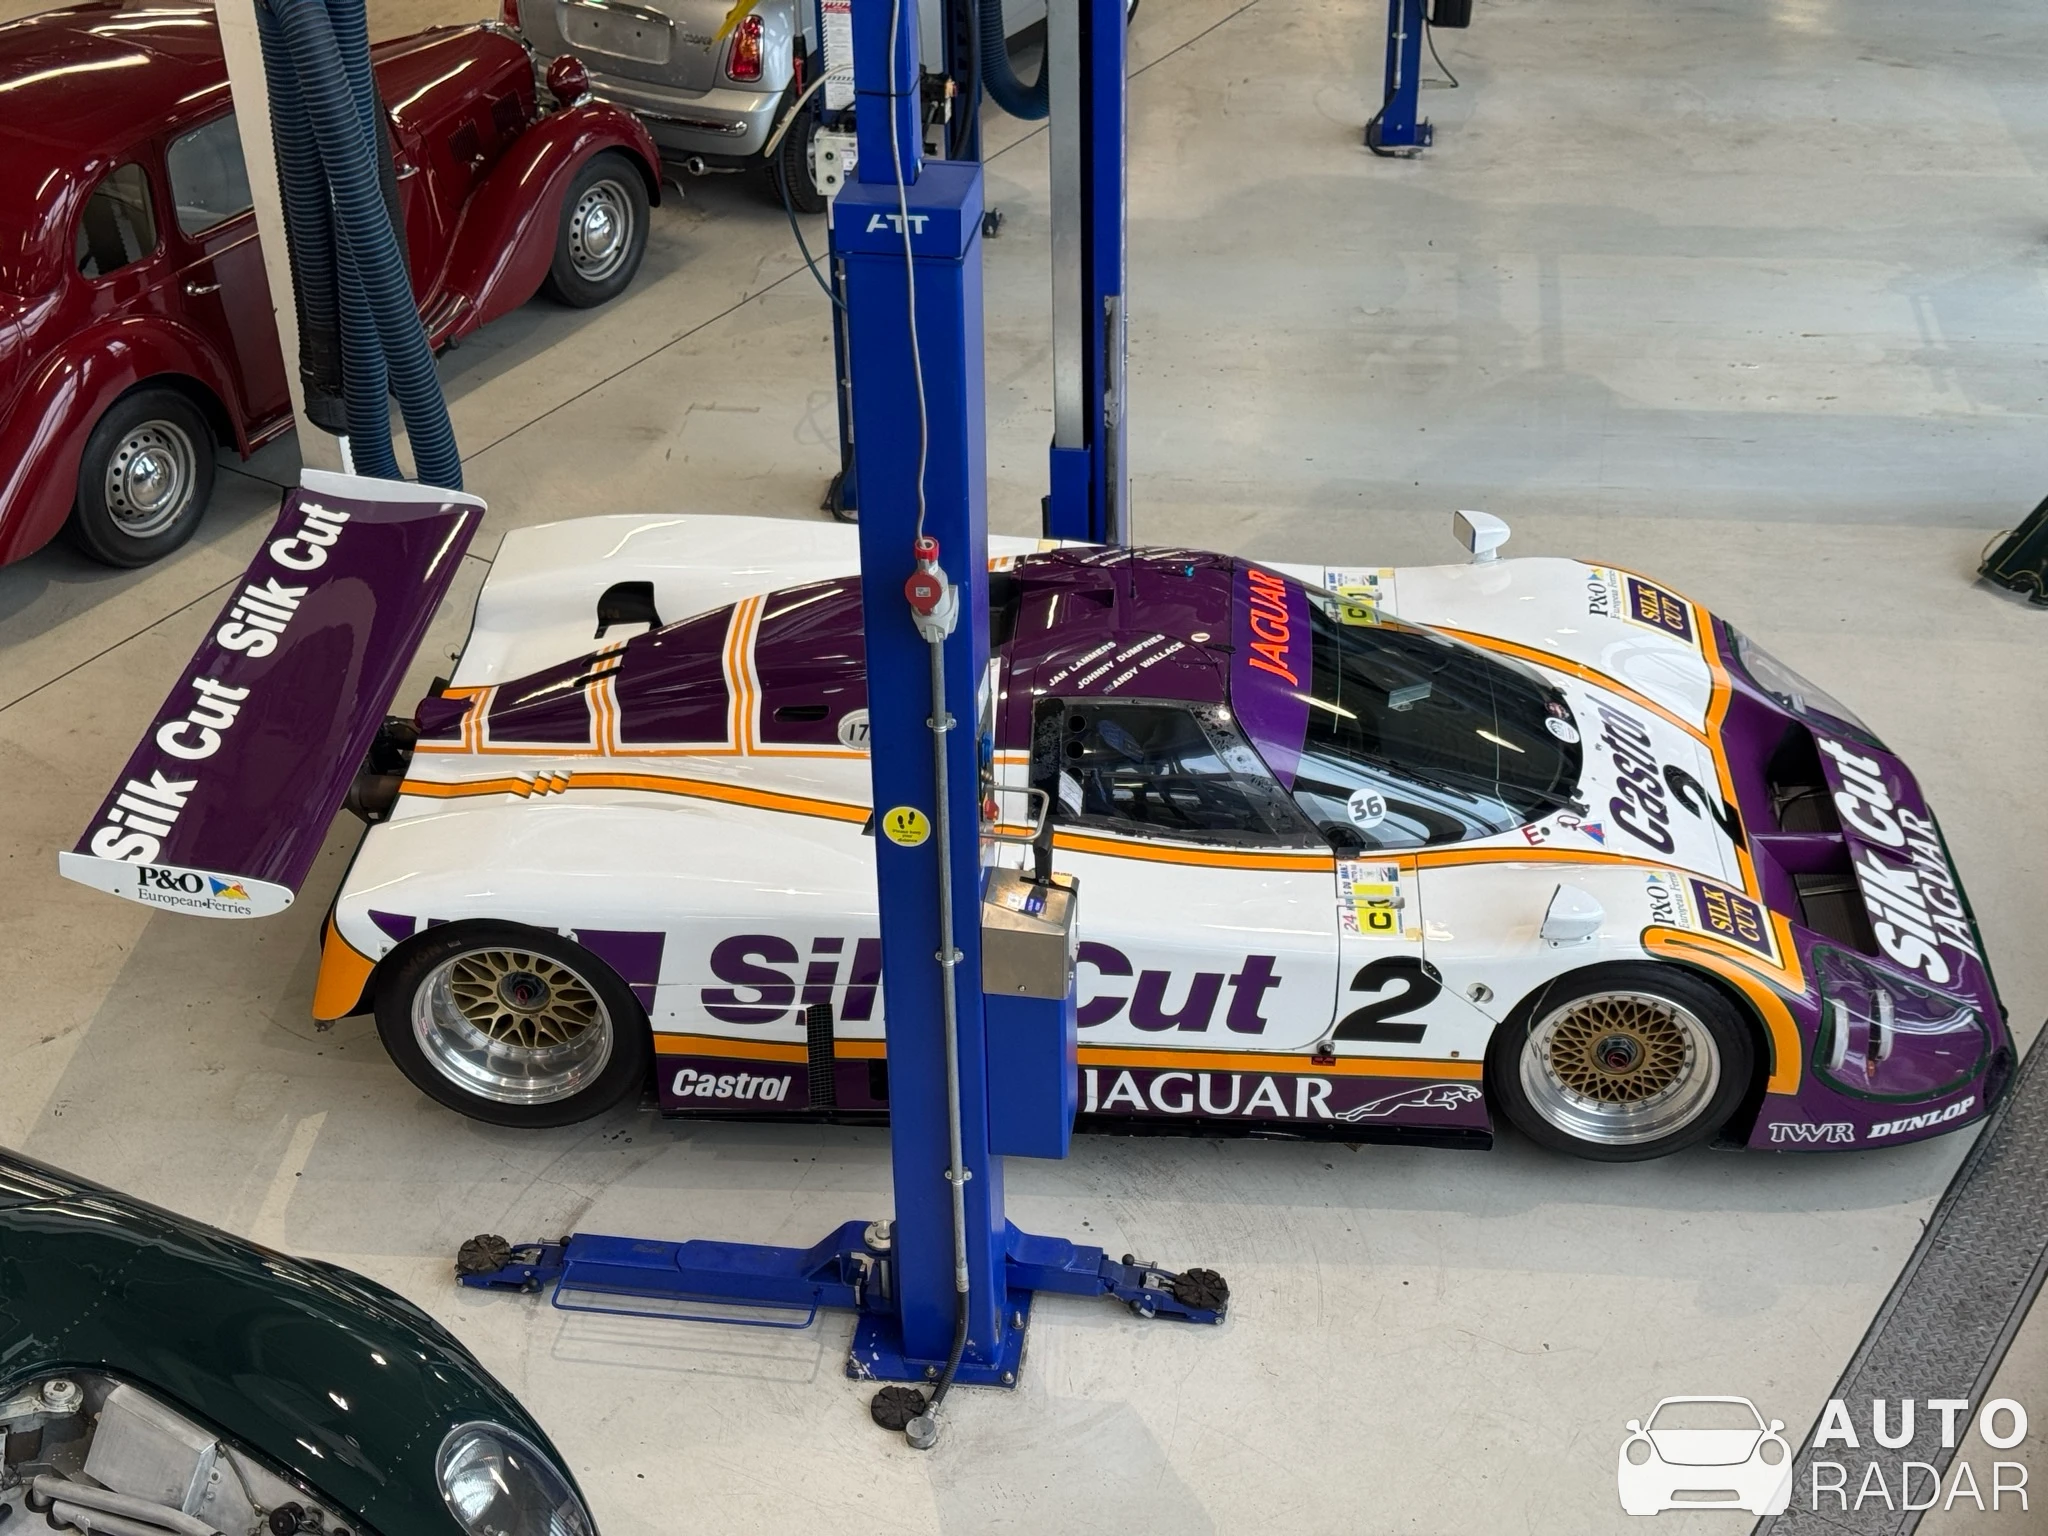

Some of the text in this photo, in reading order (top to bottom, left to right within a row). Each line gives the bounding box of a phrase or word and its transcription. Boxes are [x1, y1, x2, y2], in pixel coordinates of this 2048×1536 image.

[866, 214, 930, 234] ATT
[1587, 583, 1608, 617] P&O
[1637, 585, 1661, 623] SILK
[1661, 597, 1684, 630] CUT
[1248, 570, 1298, 687] JAGUAR
[90, 502, 351, 863] Silk Cut Silk Cut
[1049, 641, 1117, 687] JAN LAMMERS
[1078, 634, 1165, 689] JOHNNY DUMFRIES
[1112, 642, 1185, 688] ANDY WALLACE
[849, 724, 870, 741] 17
[1584, 693, 1675, 855] Castrol
[1817, 737, 1905, 847] Cut
[1350, 796, 1382, 821] 36
[1663, 764, 1748, 854] 2
[1522, 825, 1545, 845] E
[137, 866, 204, 893] P&O
[1897, 808, 1983, 963] JAGUAR
[1342, 914, 1359, 932] 24
[1646, 886, 1676, 926] P&O
[1702, 886, 1735, 935] SILK
[1728, 899, 1760, 942] CUT
[1856, 849, 1950, 984] Silk
[700, 933, 886, 1025] Sil
[1332, 955, 1442, 1044] 2
[672, 1068, 792, 1102] Castrol
[1084, 1069, 1336, 1120] JAGUAR
[1768, 1096, 1975, 1143] TWR DUNLOP
